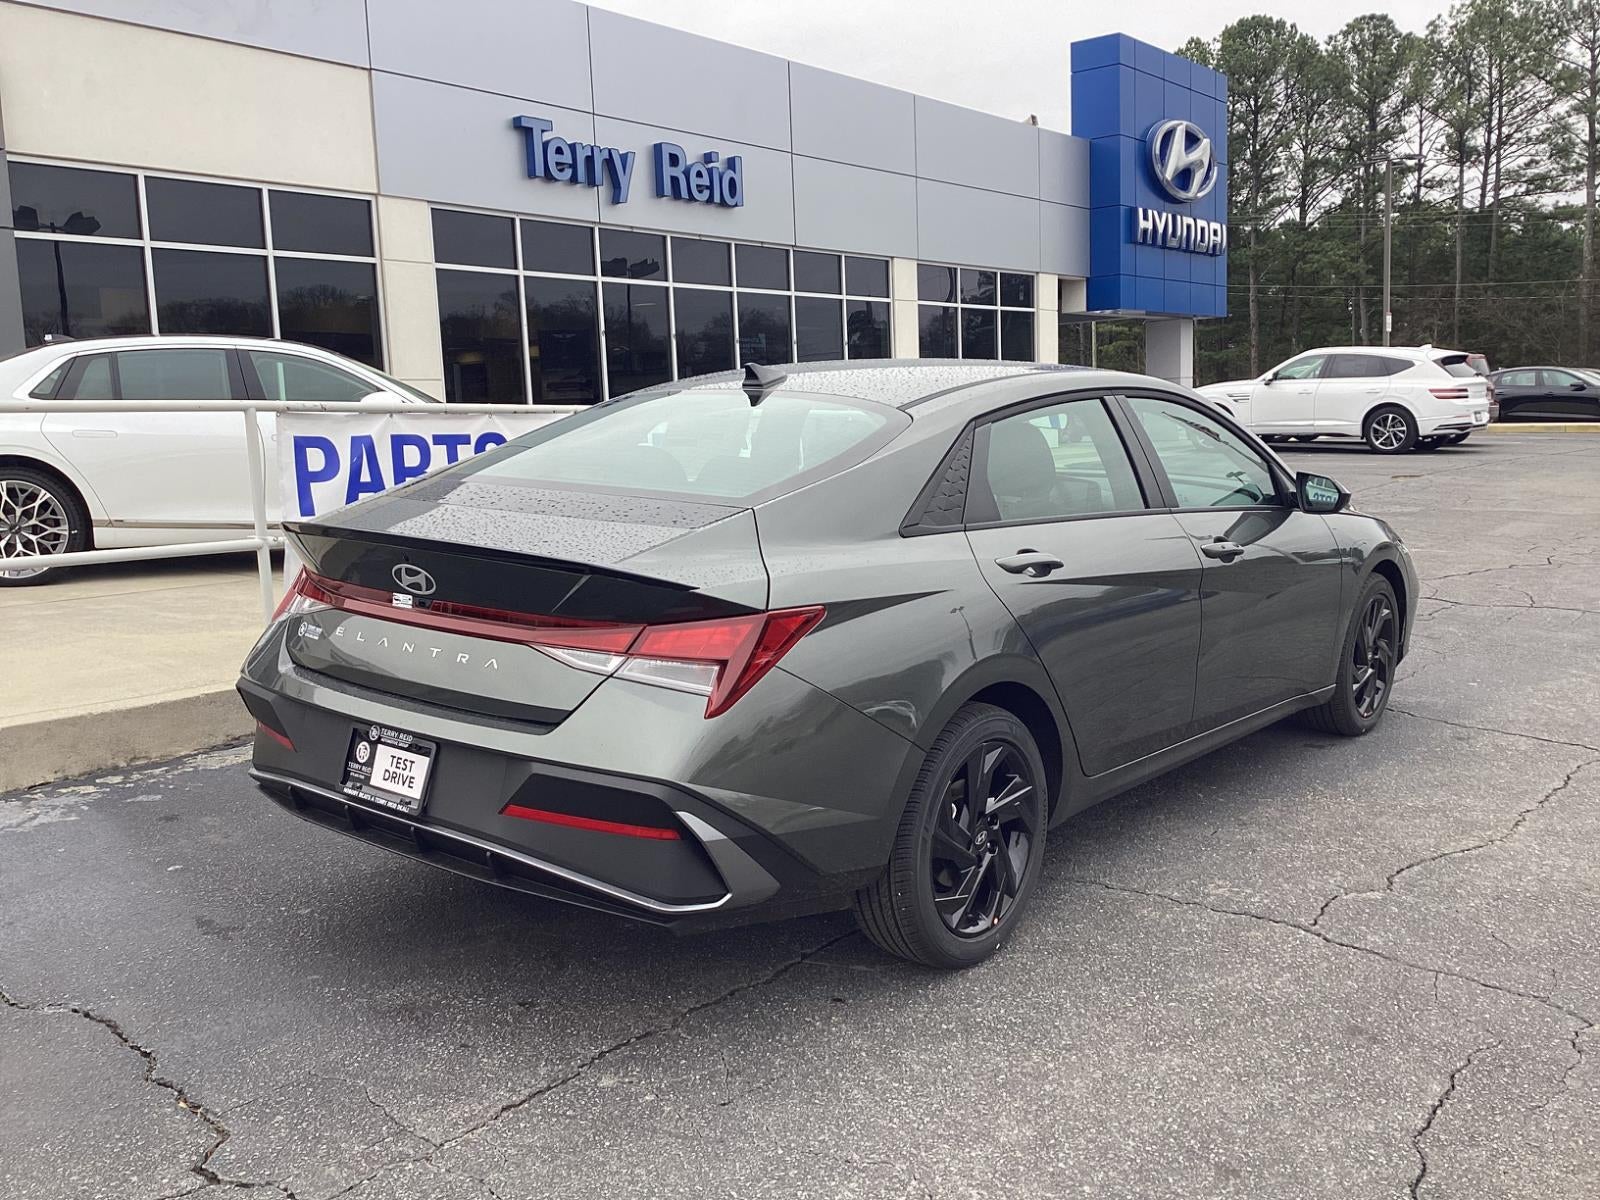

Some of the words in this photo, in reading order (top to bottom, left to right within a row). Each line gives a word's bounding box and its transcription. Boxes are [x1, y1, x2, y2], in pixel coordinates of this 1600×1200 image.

[513, 115, 635, 205] Terry
[653, 142, 744, 208] Reid
[1137, 207, 1227, 255] HYUNDAI
[293, 431, 508, 517] PART
[335, 626, 498, 670] ELANTRA
[381, 728, 399, 738] TERRY
[399, 732, 413, 741] REID
[382, 769, 415, 789] DRIVE
[390, 755, 415, 773] TEST
